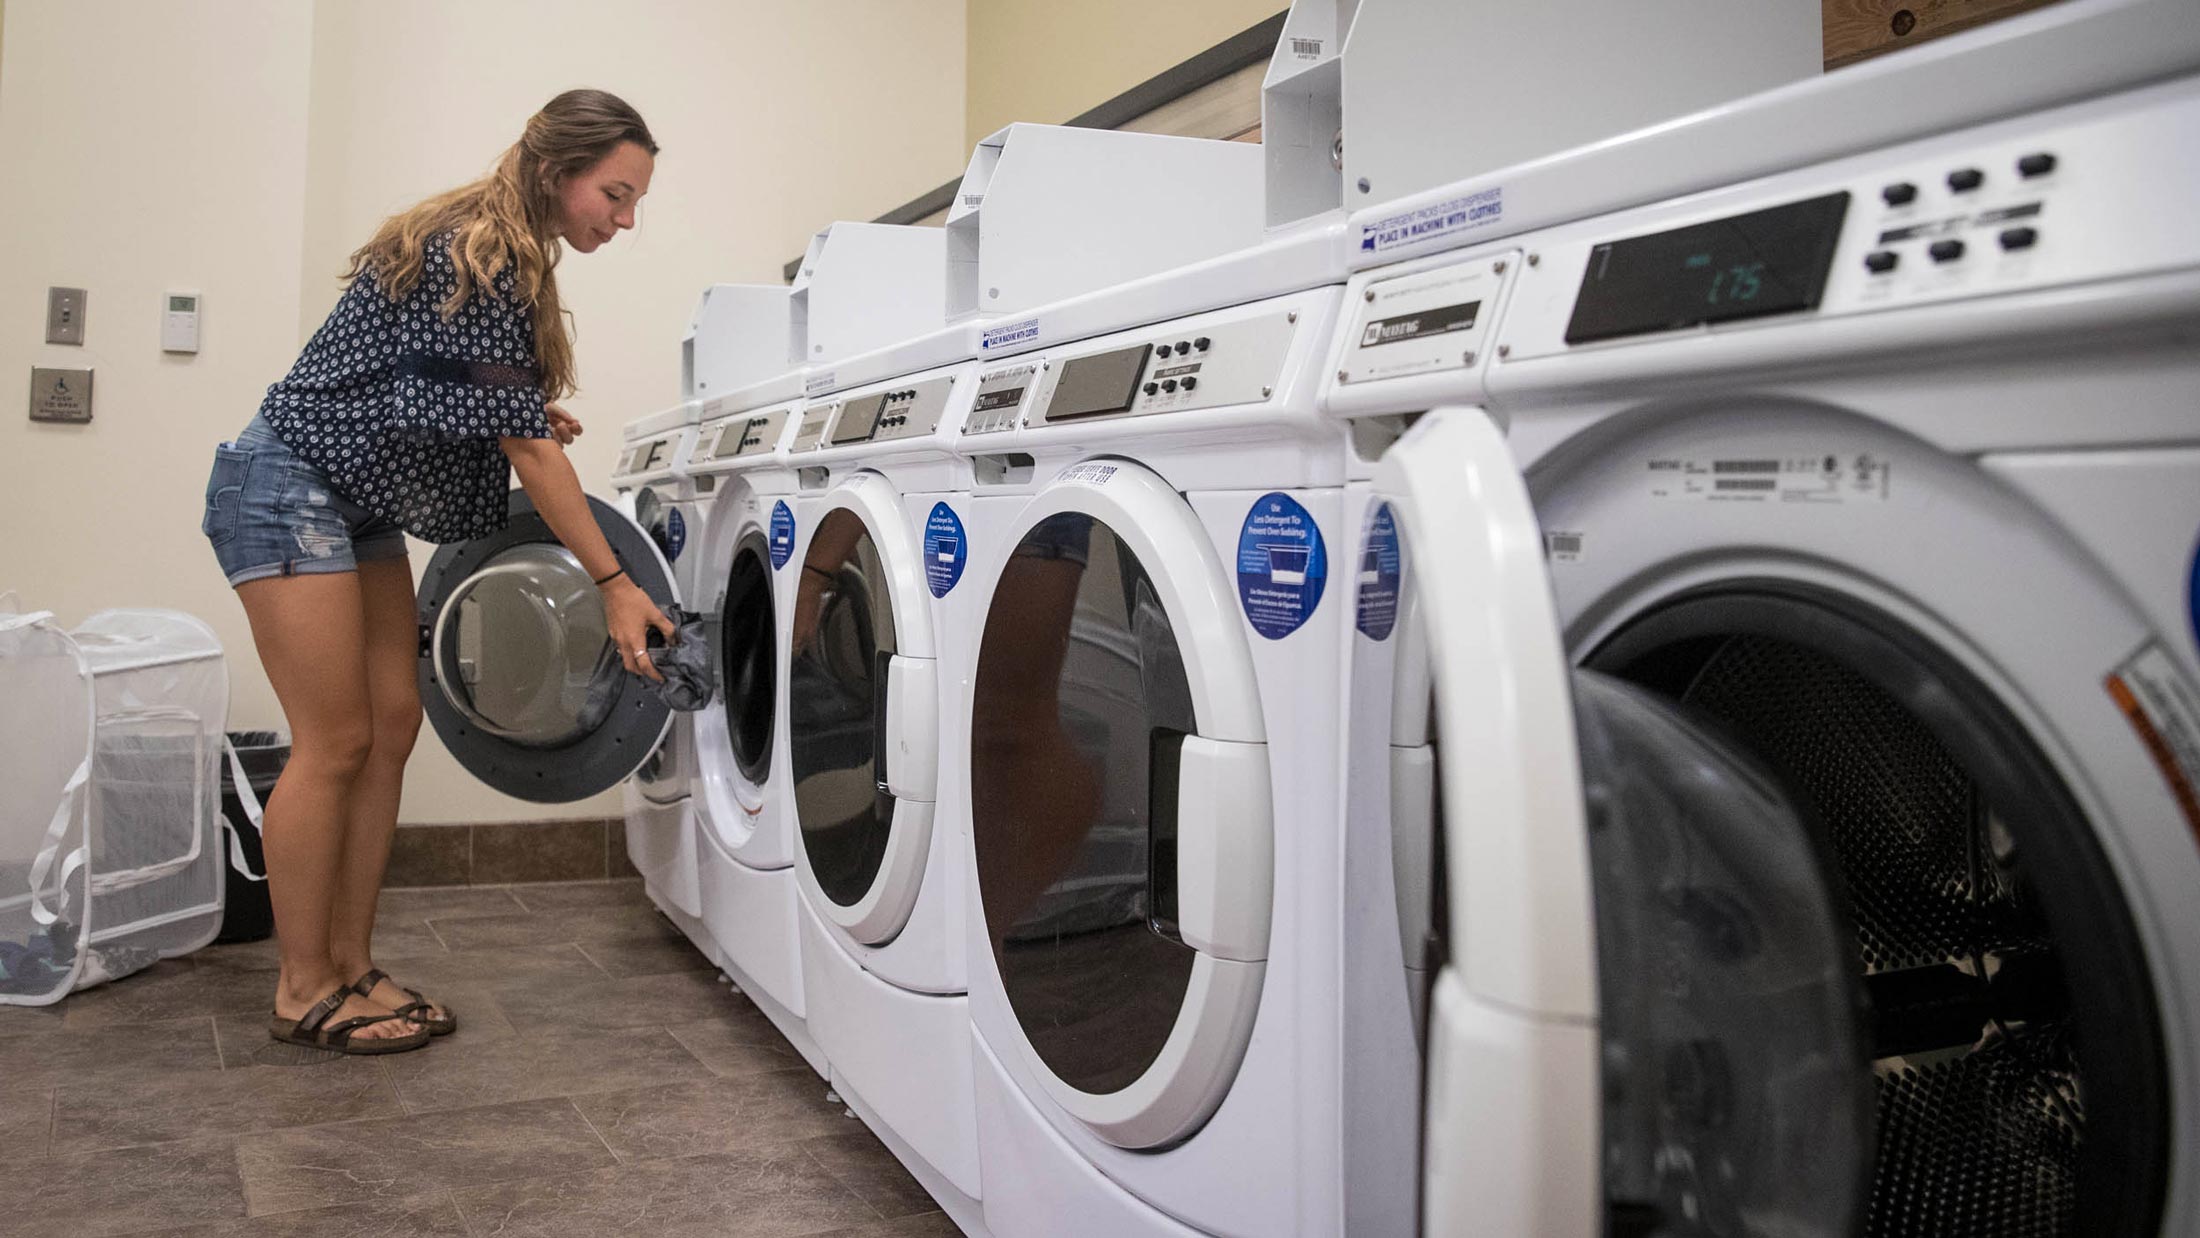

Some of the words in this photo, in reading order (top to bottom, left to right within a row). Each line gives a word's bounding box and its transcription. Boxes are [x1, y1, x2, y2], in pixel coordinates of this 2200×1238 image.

[1379, 230, 1398, 244] PLACE
[1400, 227, 1409, 239] IN
[1411, 217, 1445, 235] MACHINE
[1446, 211, 1466, 226] WITH
[1469, 201, 1502, 221] CLOTHES
